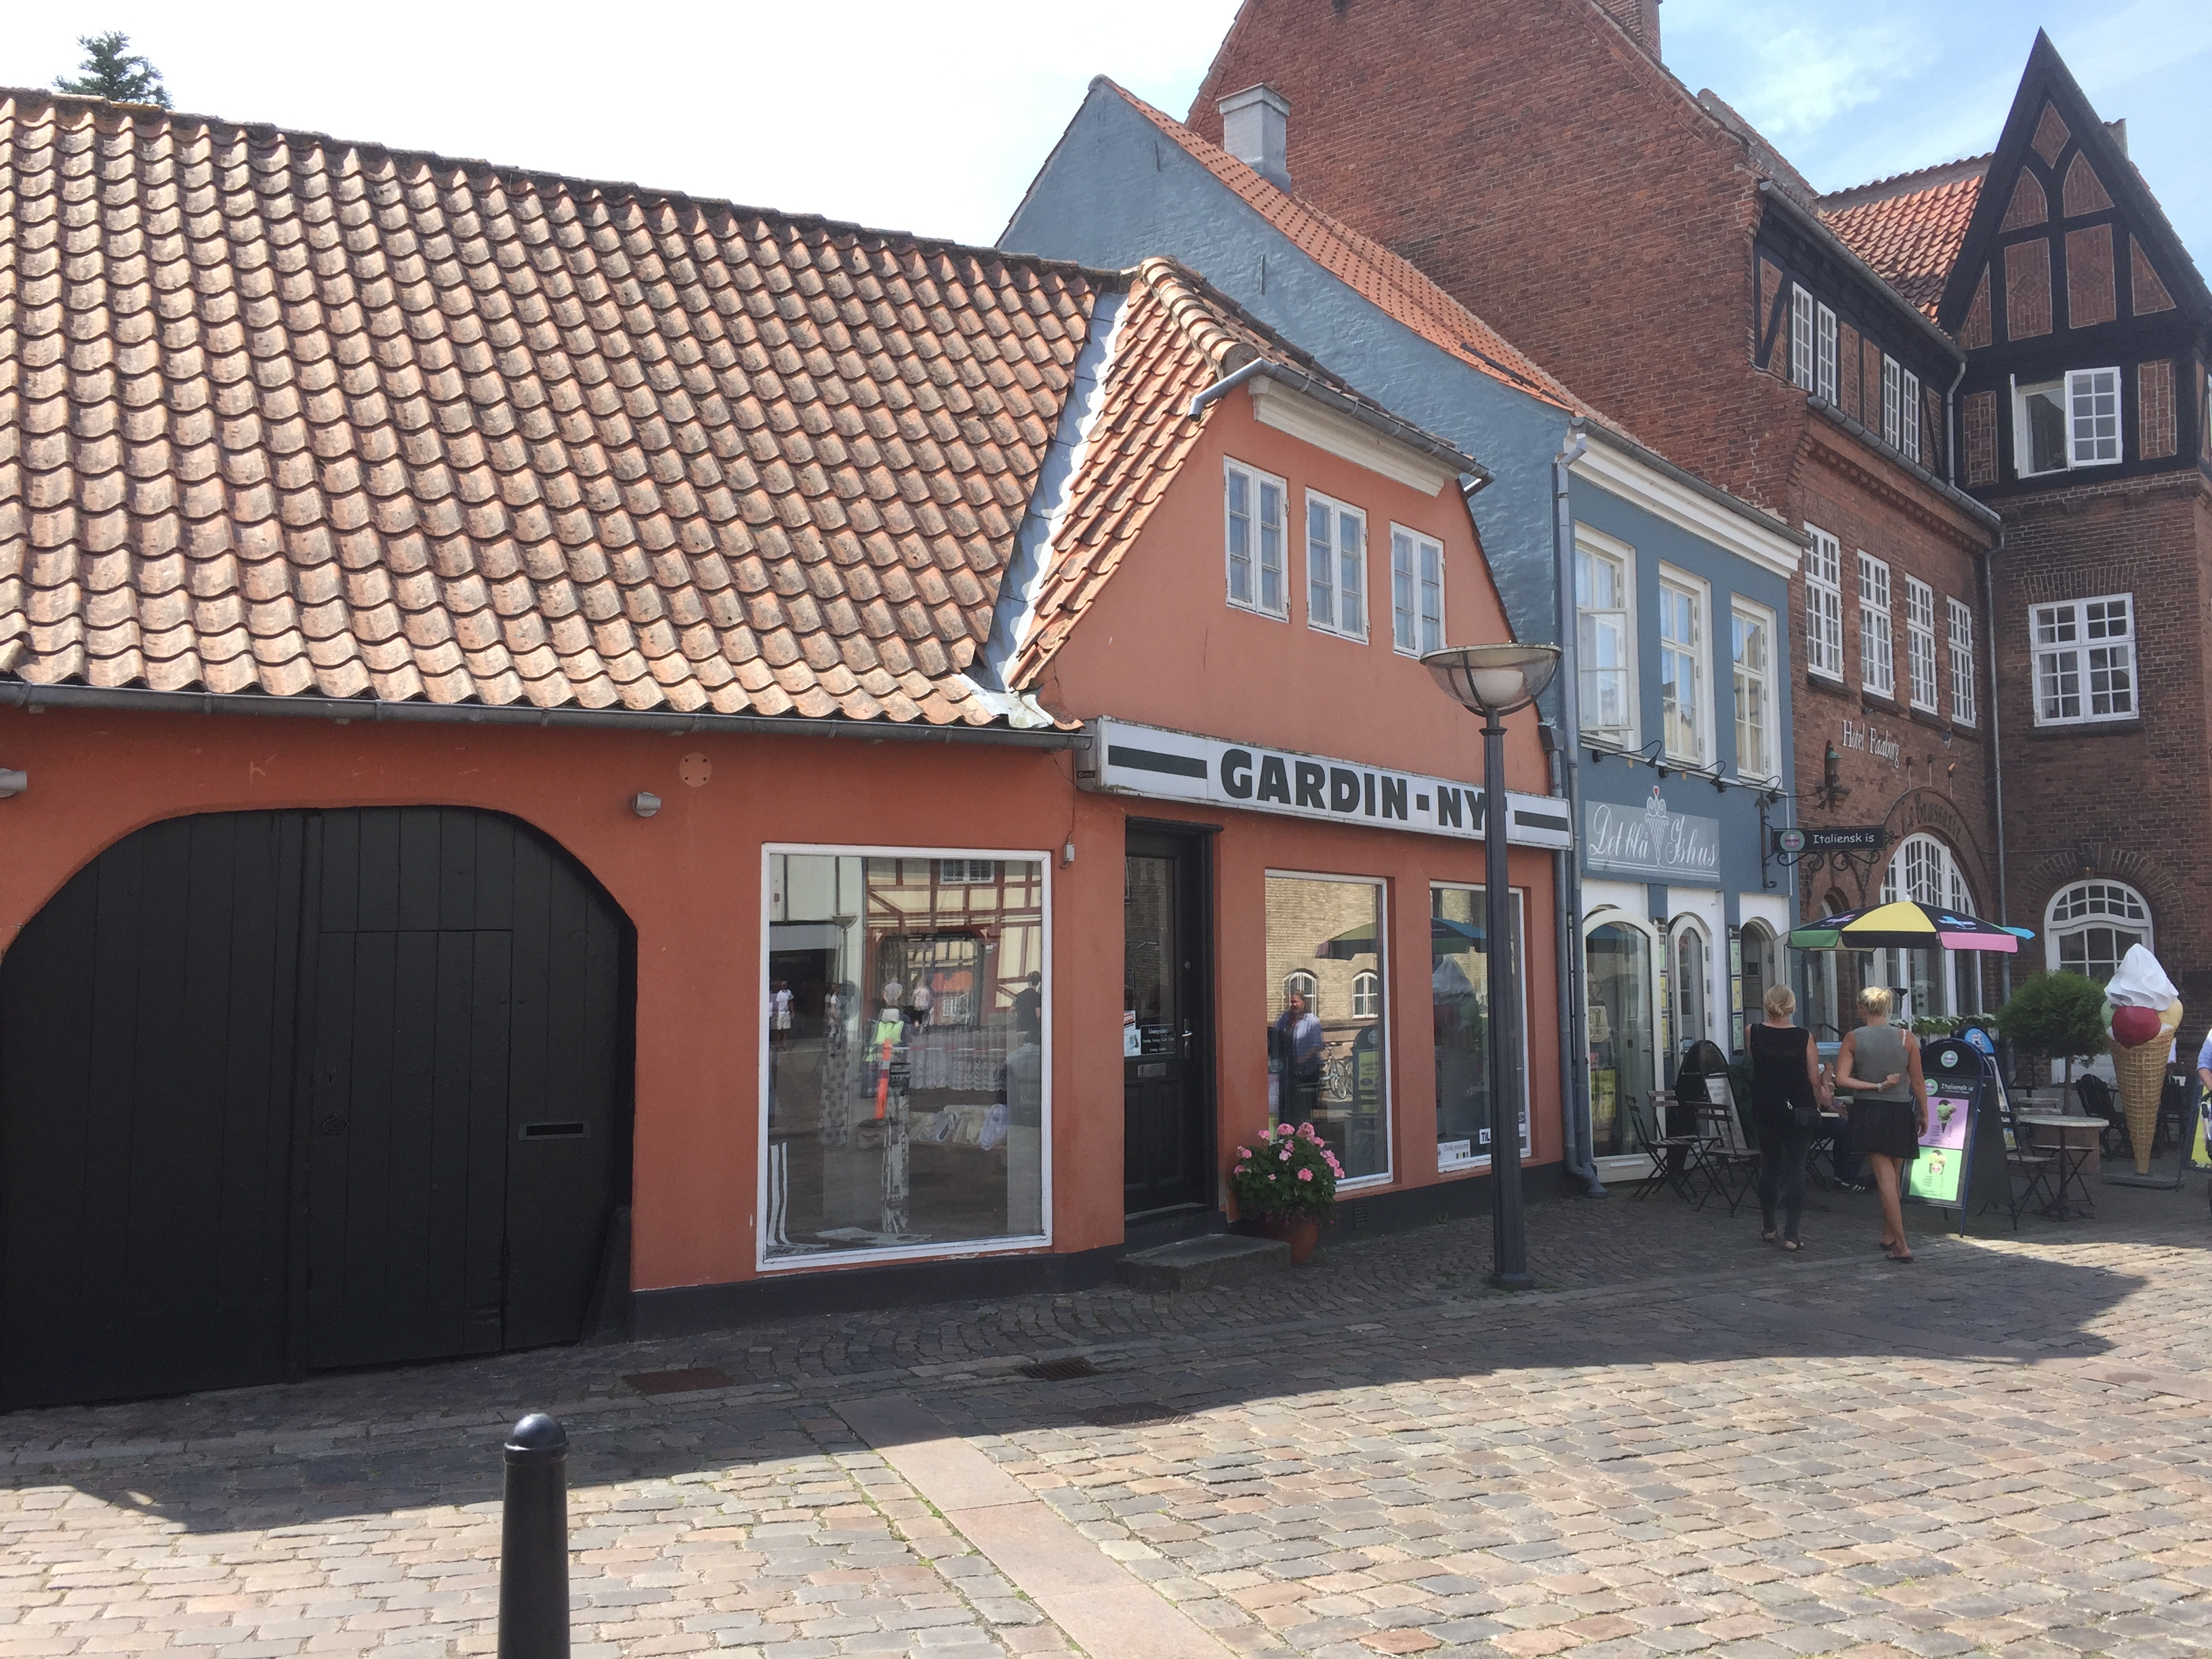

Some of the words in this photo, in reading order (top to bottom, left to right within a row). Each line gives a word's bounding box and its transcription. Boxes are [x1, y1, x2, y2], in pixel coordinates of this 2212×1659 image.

[1842, 719, 1865, 752] Hotel
[1870, 727, 1899, 769] Faaborg
[1221, 748, 1507, 831] GARDIN-NY
[1589, 804, 1622, 856] Det
[1625, 821, 1650, 859] blå
[1813, 834, 1862, 844] Italiensk
[1865, 832, 1875, 842] is
[1941, 1083, 1967, 1091] Italiensk
